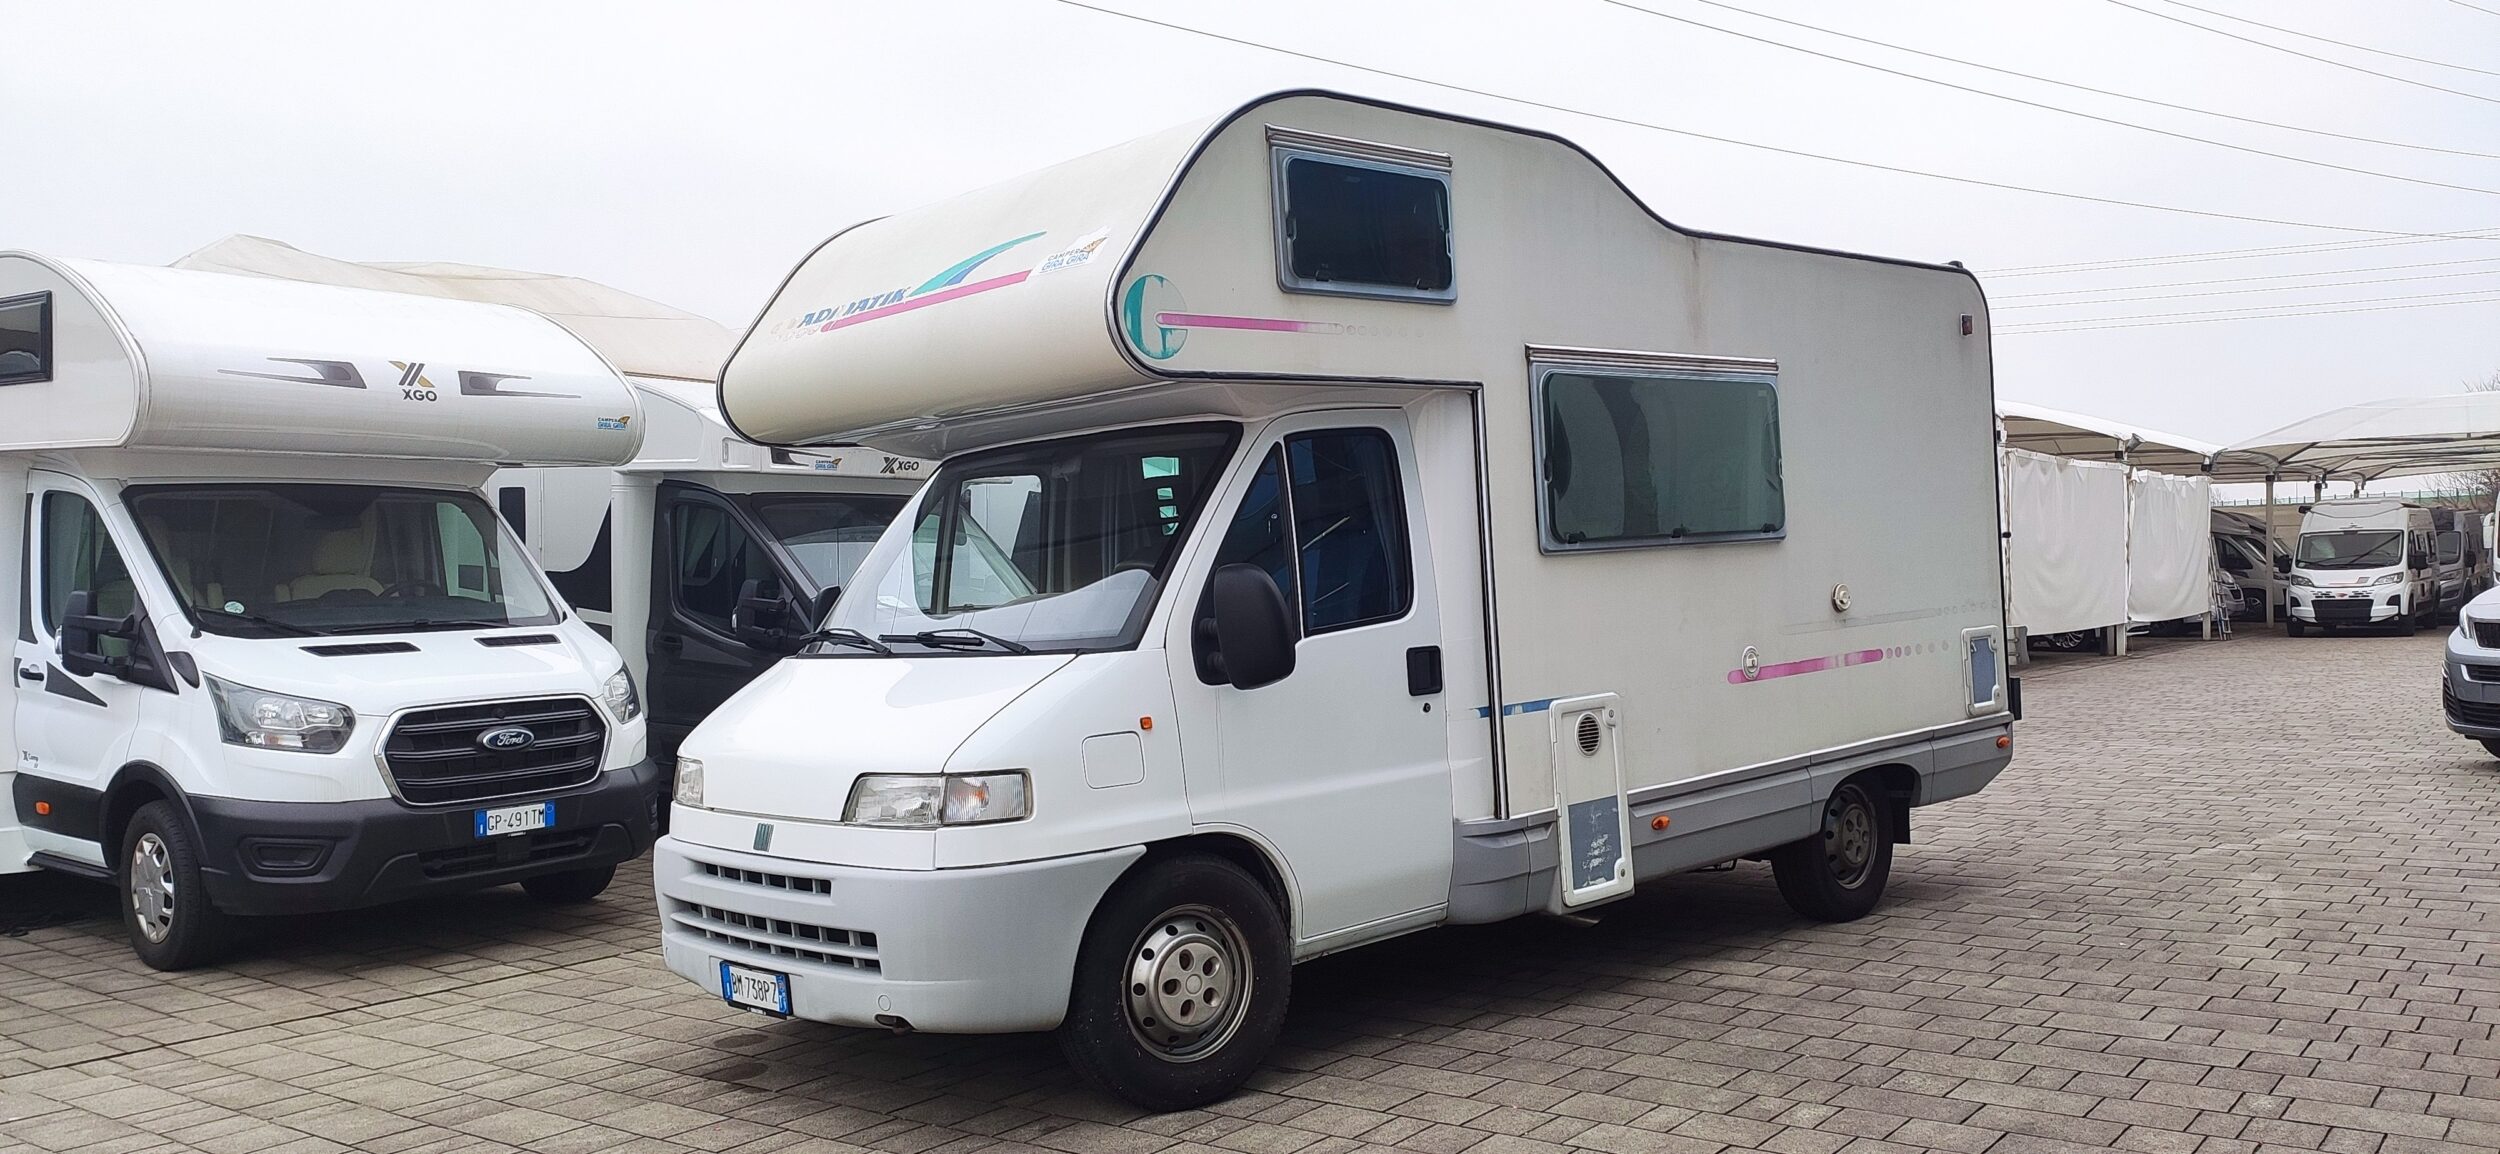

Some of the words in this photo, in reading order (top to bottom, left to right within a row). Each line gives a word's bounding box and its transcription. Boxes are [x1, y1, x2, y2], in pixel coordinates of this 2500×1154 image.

[402, 388, 438, 402] XGO
[896, 461, 920, 471] XGO
[497, 732, 525, 746] Ford
[730, 972, 744, 997] BM
[744, 976, 778, 1005] 738PZ
